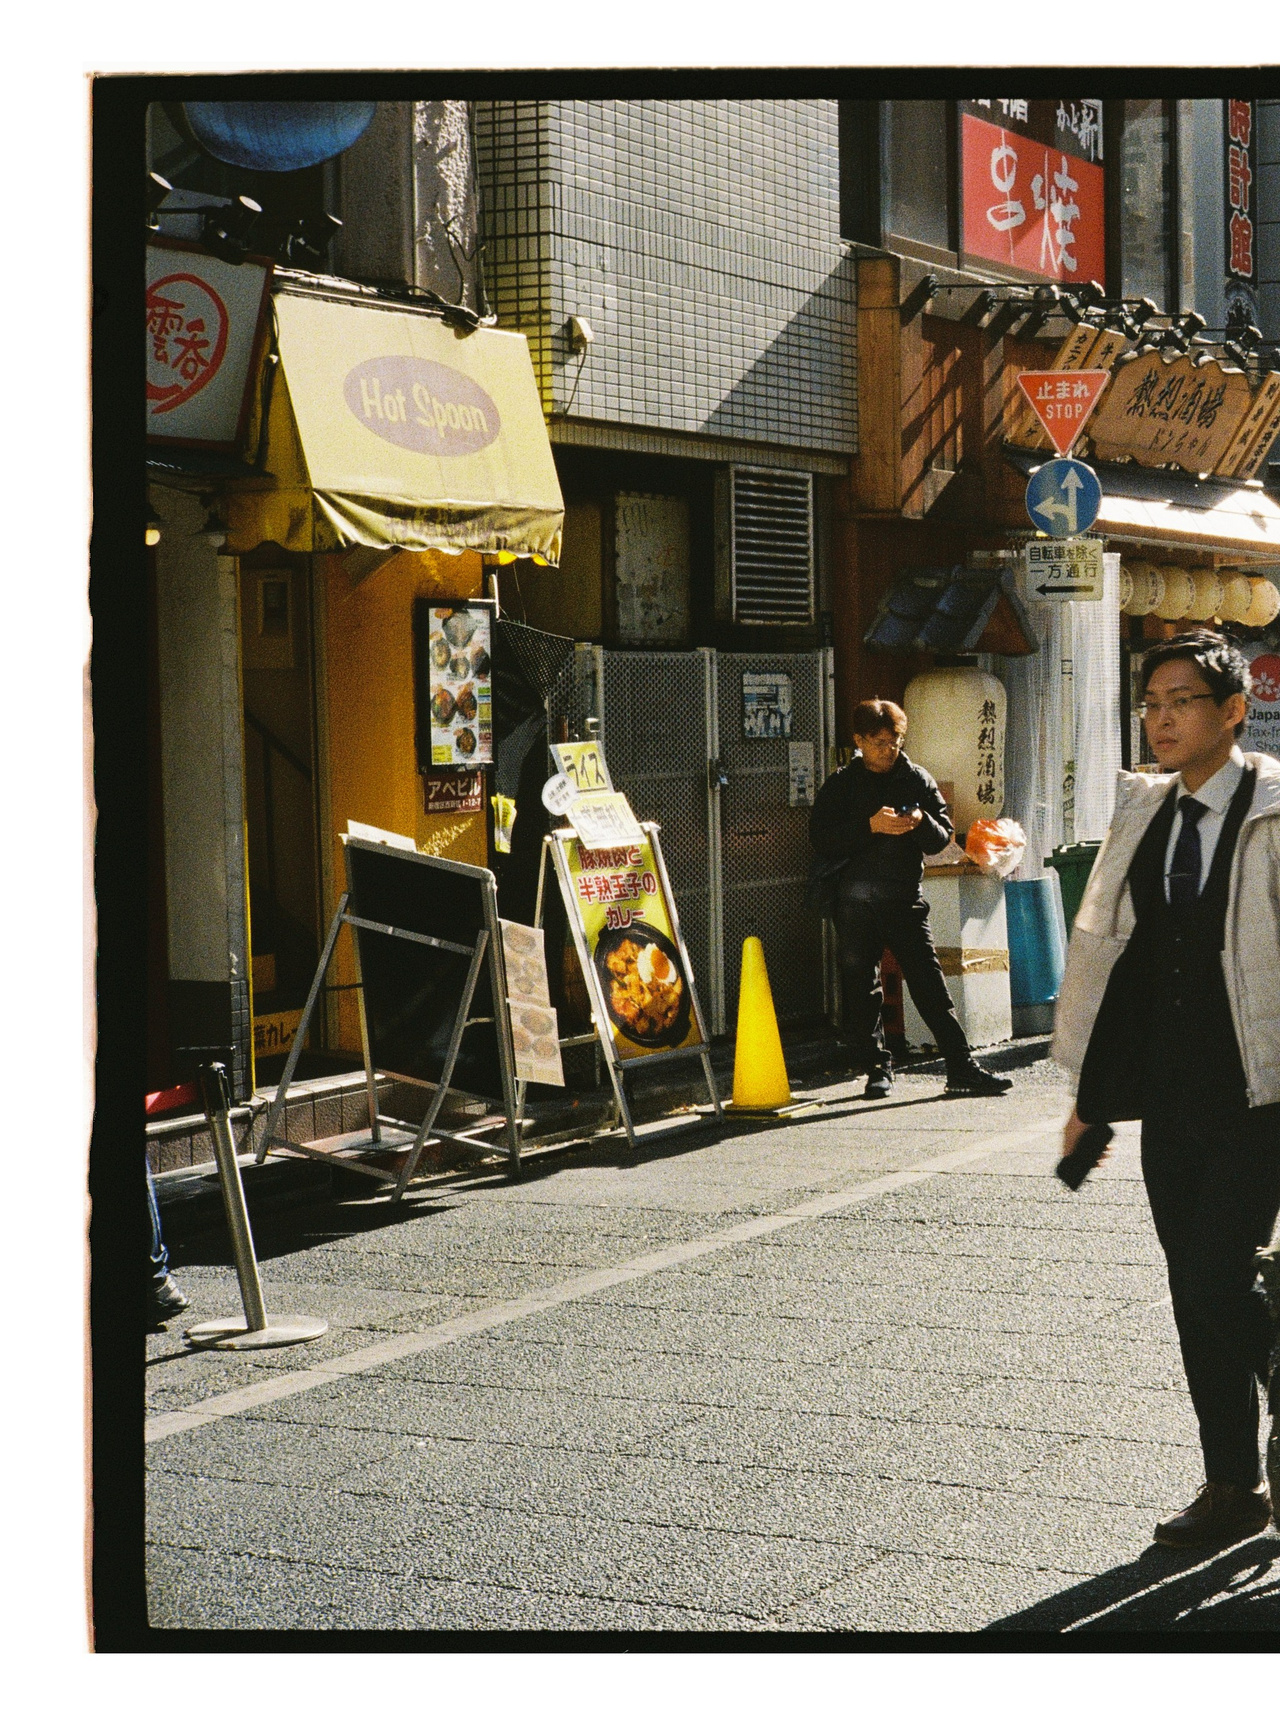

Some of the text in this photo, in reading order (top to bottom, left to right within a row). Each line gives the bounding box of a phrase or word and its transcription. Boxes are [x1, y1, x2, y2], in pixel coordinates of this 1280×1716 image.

[1036, 380, 1091, 400] 止まれ
[360, 378, 489, 438] Hot Spoon
[1046, 403, 1083, 419] STOP
[1029, 544, 1098, 560] 自転車を除く
[1029, 563, 1098, 579] 一方通行
[976, 699, 997, 805] 熱烈酒場
[562, 751, 606, 788] ライス
[427, 777, 481, 800] アベビル
[578, 872, 658, 904] 半熟玉子の
[605, 905, 645, 931] カレー
